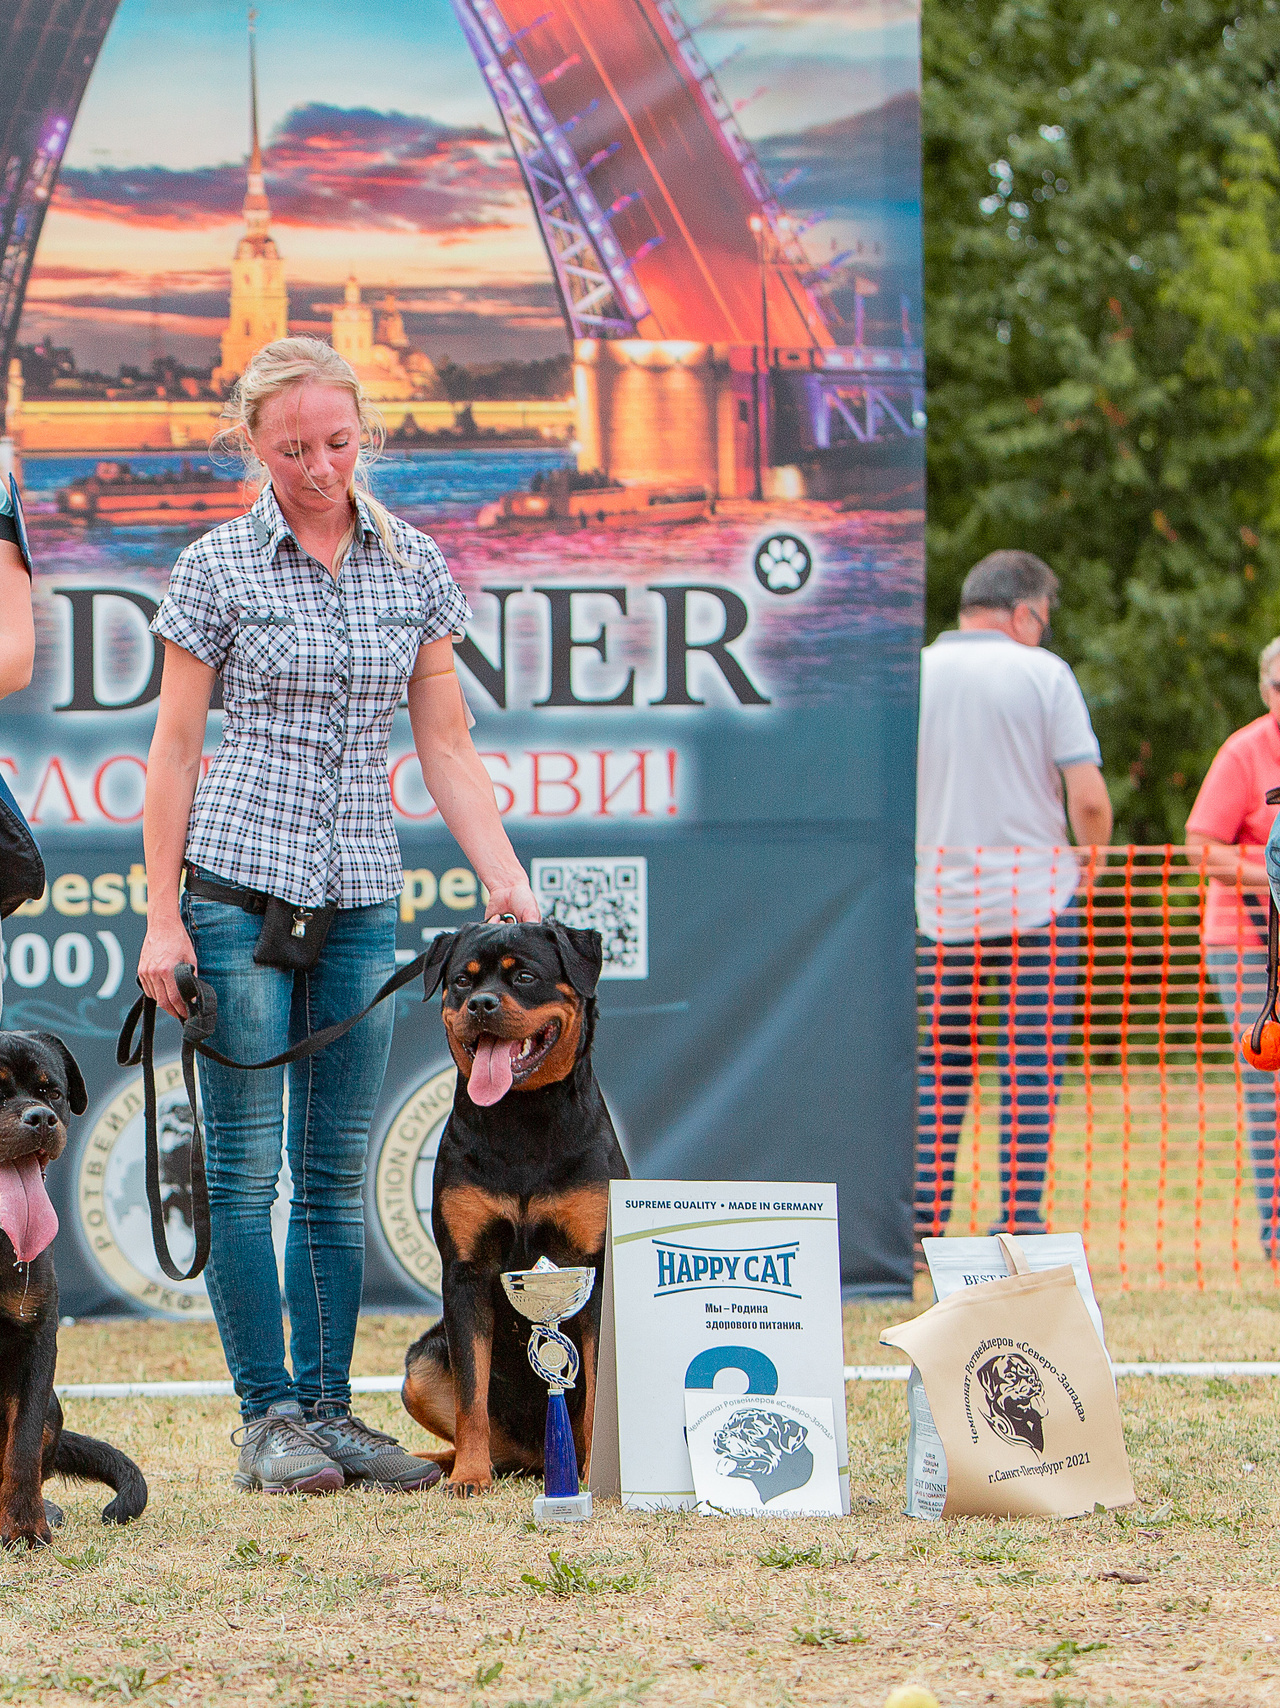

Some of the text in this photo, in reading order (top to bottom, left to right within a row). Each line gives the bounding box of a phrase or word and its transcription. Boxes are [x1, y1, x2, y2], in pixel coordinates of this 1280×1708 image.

[624, 1199, 824, 1212] SUPREME QUALITY MADE IN GERMANY
[656, 1249, 796, 1288] HAPPY CAT
[705, 1303, 722, 1314] Мы
[731, 1303, 769, 1315] Родина
[705, 1320, 804, 1331] здорового питания.
[965, 1337, 1014, 1375] Ротвейлеров
[963, 1375, 979, 1444] Чемпионат
[1065, 1452, 1091, 1469] 2021
